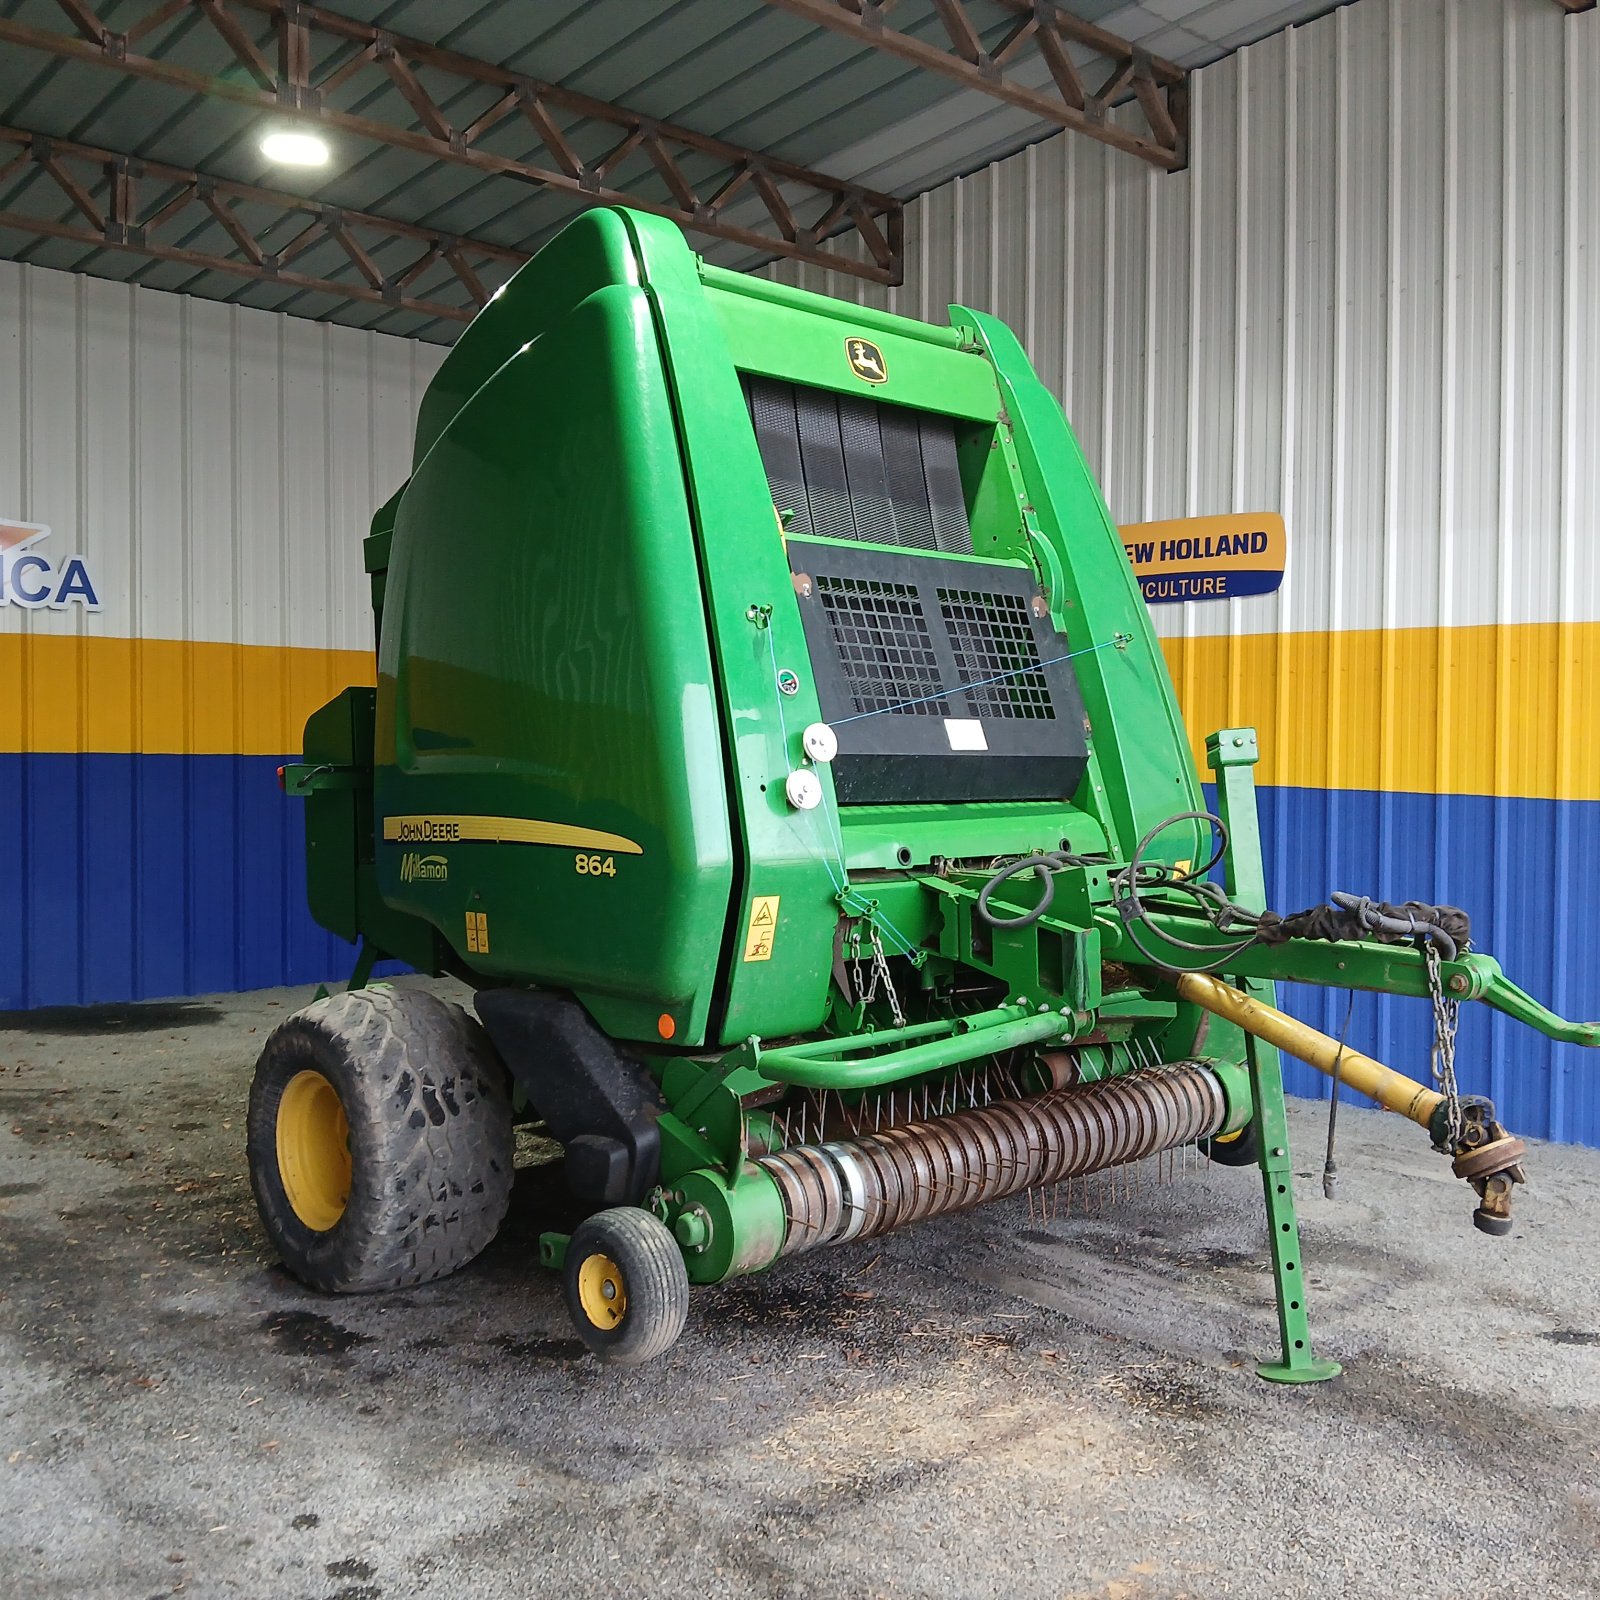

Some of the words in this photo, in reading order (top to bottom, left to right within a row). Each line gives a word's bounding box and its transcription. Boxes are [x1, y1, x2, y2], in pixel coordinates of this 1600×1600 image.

[1159, 531, 1268, 561] HOLLAND
[398, 821, 423, 839] JOHN
[423, 820, 460, 840] DEERE
[575, 853, 617, 878] 864
